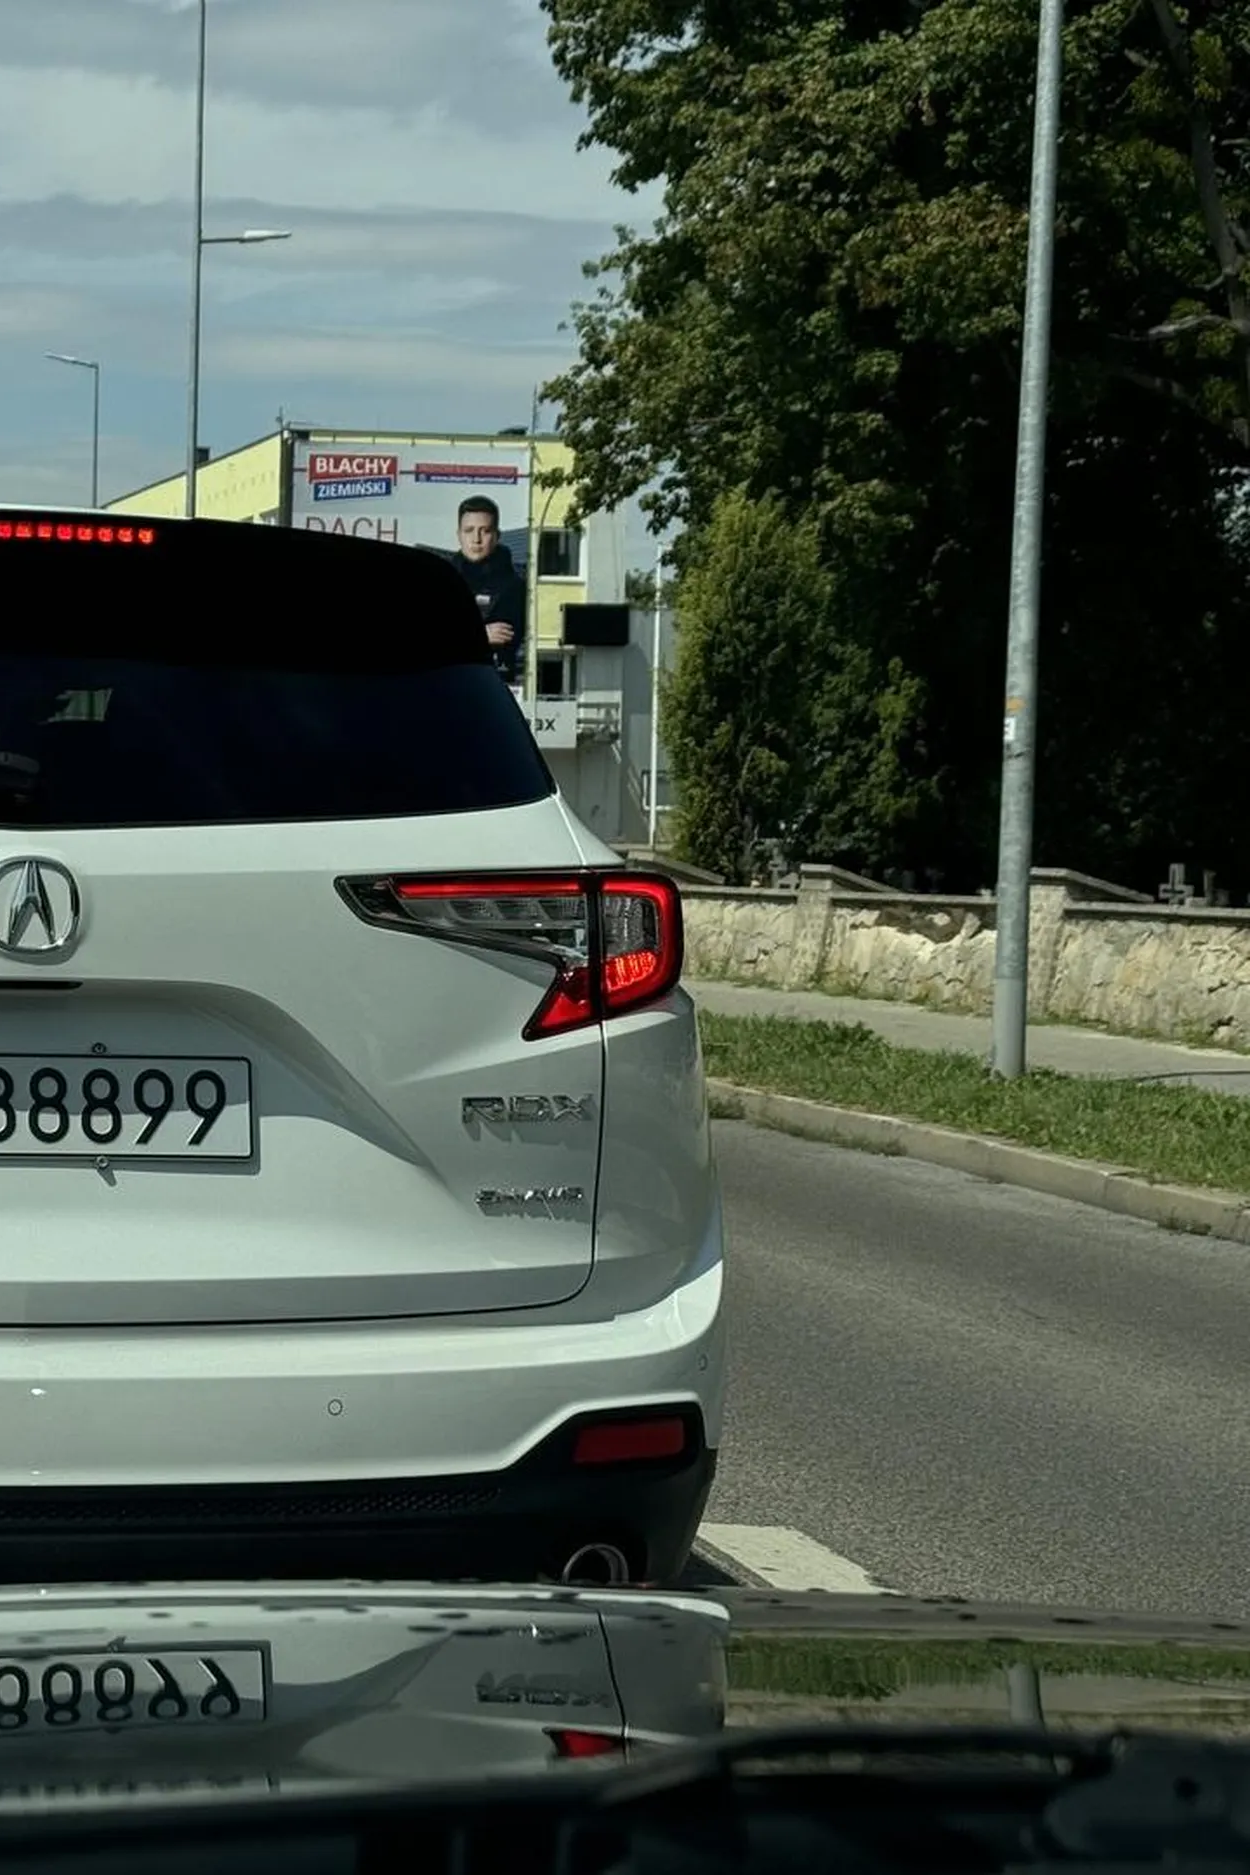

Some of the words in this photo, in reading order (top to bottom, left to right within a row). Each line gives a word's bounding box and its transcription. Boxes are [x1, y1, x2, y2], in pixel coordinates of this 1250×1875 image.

[315, 457, 392, 474] BLACHY
[317, 480, 386, 498] ZIEMIŃSKI
[461, 1094, 593, 1123] RDX
